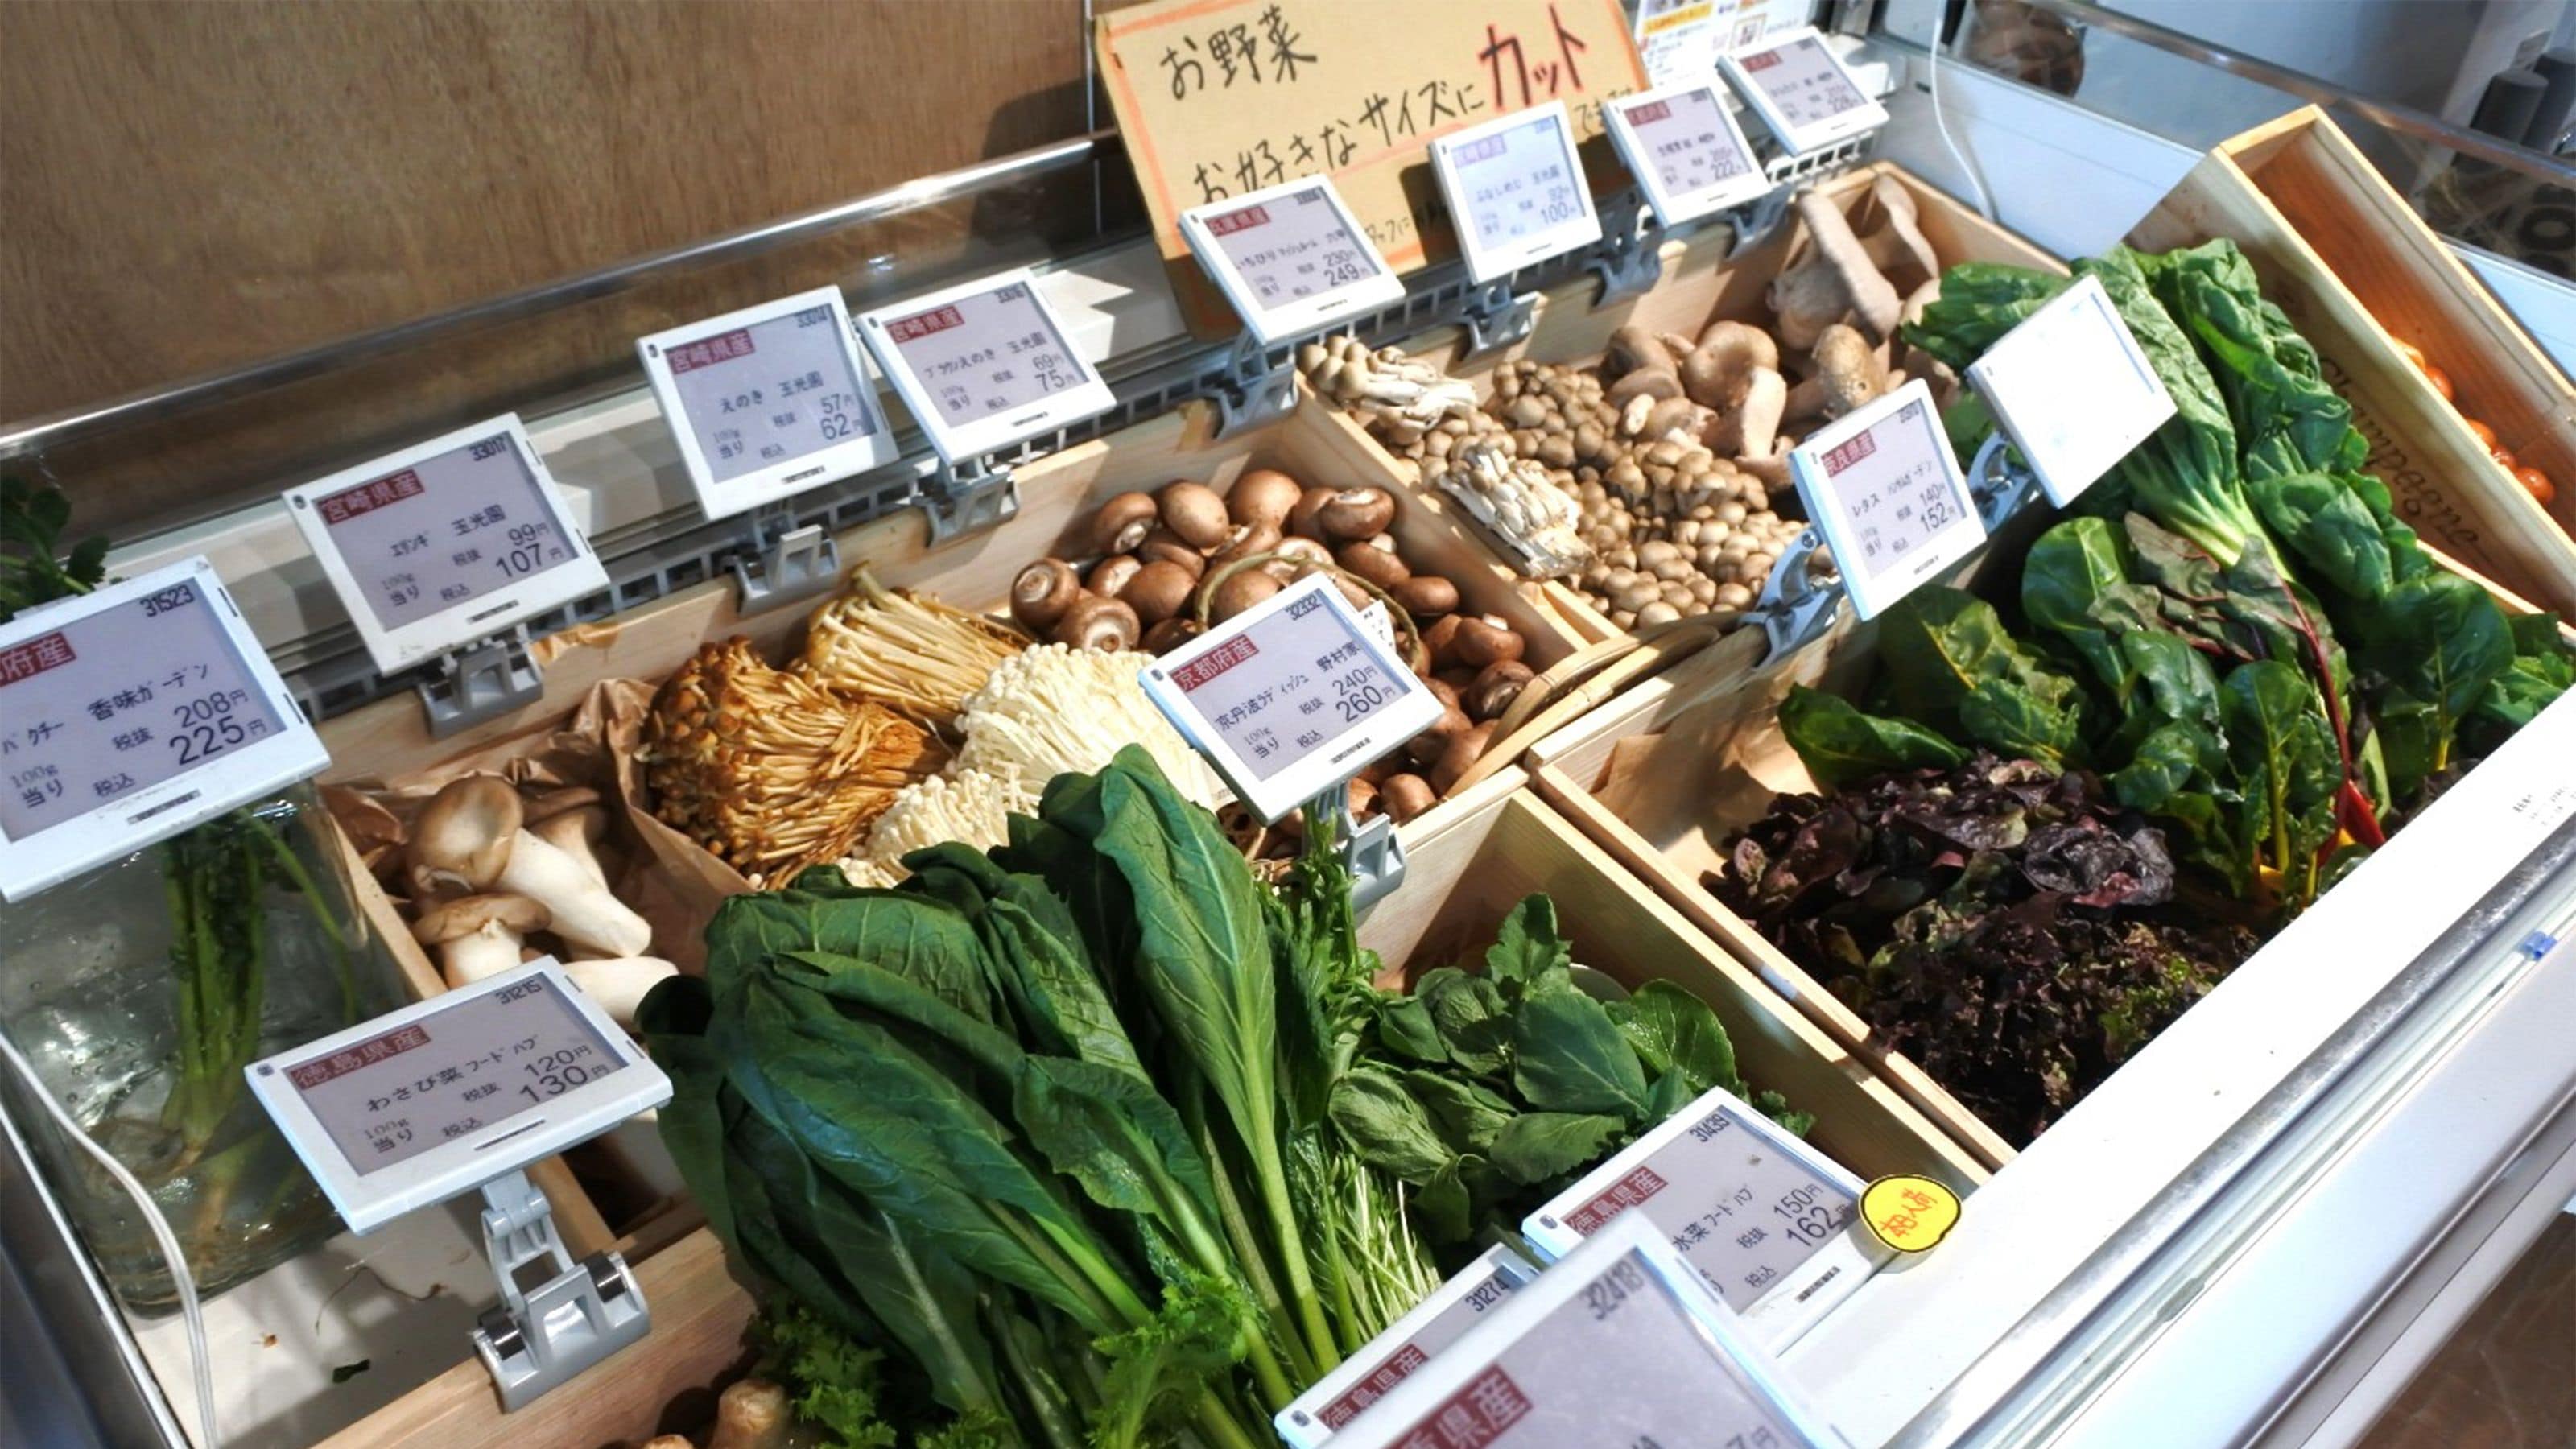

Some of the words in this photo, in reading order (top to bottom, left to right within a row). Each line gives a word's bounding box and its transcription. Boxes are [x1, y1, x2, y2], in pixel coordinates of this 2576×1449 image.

[1160, 4, 1319, 100] お野菜
[1480, 3, 1586, 109] カット
[667, 330, 754, 374] 宮崎県産
[722, 390, 762, 413] えのき
[320, 471, 422, 522] 宮崎県産
[1852, 493, 1881, 518] レタス
[508, 522, 549, 547] 99円
[390, 585, 419, 606] 当り
[440, 584, 469, 601] 税込
[495, 542, 561, 578] 107円
[139, 584, 196, 617] 31523
[1286, 595, 1323, 621] 32332
[0, 635, 70, 683] 府産
[1173, 635, 1257, 691] 京都府産
[87, 664, 207, 722] 香味ガーデン
[1214, 675, 1309, 732] 京丹波ラディッシュ
[1315, 640, 1361, 672] 野村家
[1298, 697, 1325, 715] 税抜
[1331, 666, 1377, 696] 240円
[112, 727, 153, 751] 税抜
[173, 689, 248, 729] 208円
[1296, 729, 1323, 748] 税込
[1335, 685, 1393, 723] 260円
[93, 772, 135, 797] 税込
[169, 715, 266, 766] 225円
[1253, 737, 1279, 759] 当り
[21, 778, 63, 809] 当り
[495, 980, 543, 1005] 31215
[291, 1026, 429, 1089] 徳島県産
[463, 1083, 500, 1102] 税抜
[524, 1045, 592, 1077] 120円
[367, 1067, 464, 1112] わさび菜
[442, 1117, 482, 1137] 税込
[519, 1064, 610, 1103] 130円
[373, 1128, 413, 1154] 当り
[1689, 1113, 1731, 1143] 31439
[1672, 1221, 1710, 1252] 水菜
[1736, 1228, 1768, 1249] 税抜
[1773, 1183, 1823, 1220] 150円
[1465, 1274, 1510, 1313] 31274
[1580, 1261, 1645, 1322] 32418
[1744, 1265, 1777, 1288] 税込
